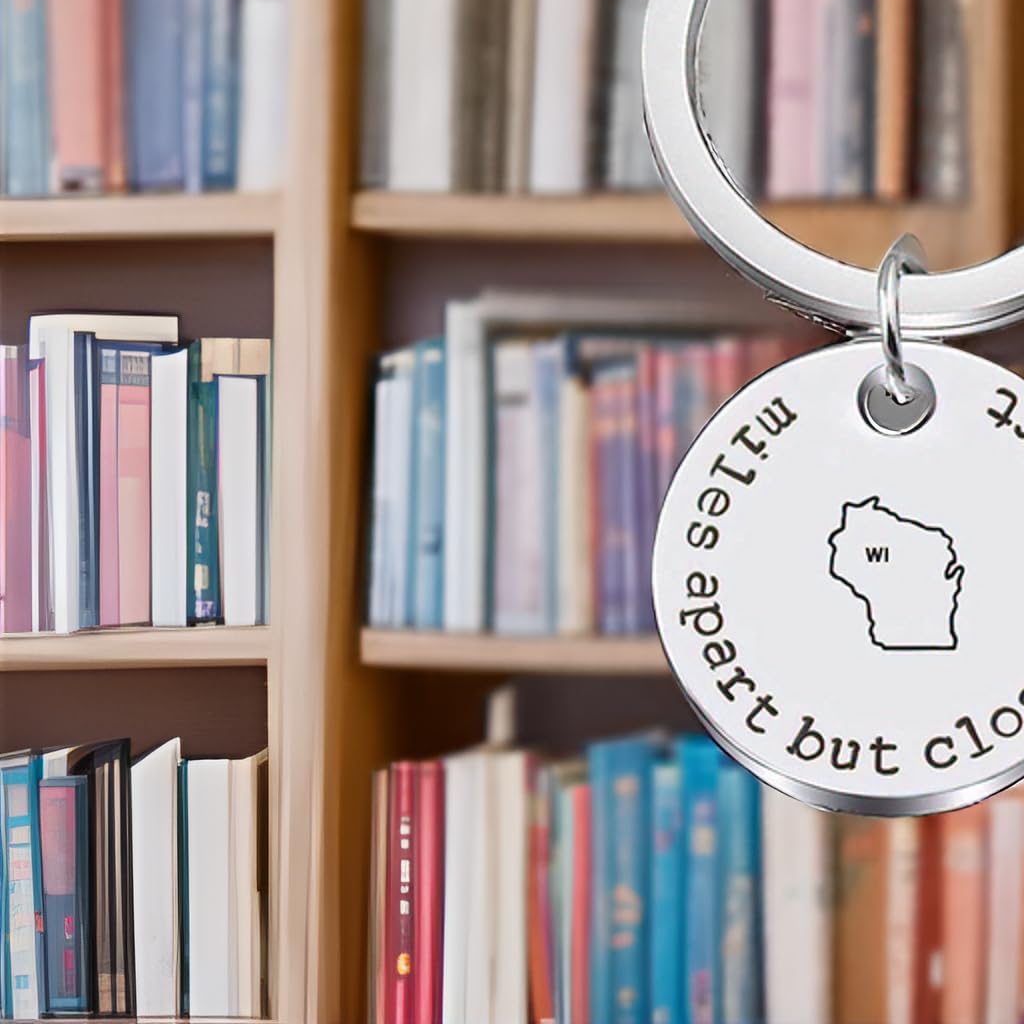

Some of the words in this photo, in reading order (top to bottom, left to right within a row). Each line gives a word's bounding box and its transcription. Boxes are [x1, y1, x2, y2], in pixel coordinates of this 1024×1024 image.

[686, 397, 798, 550] miles
[865, 546, 890, 564] WI
[680, 571, 779, 734] apart
[786, 716, 900, 776] but
